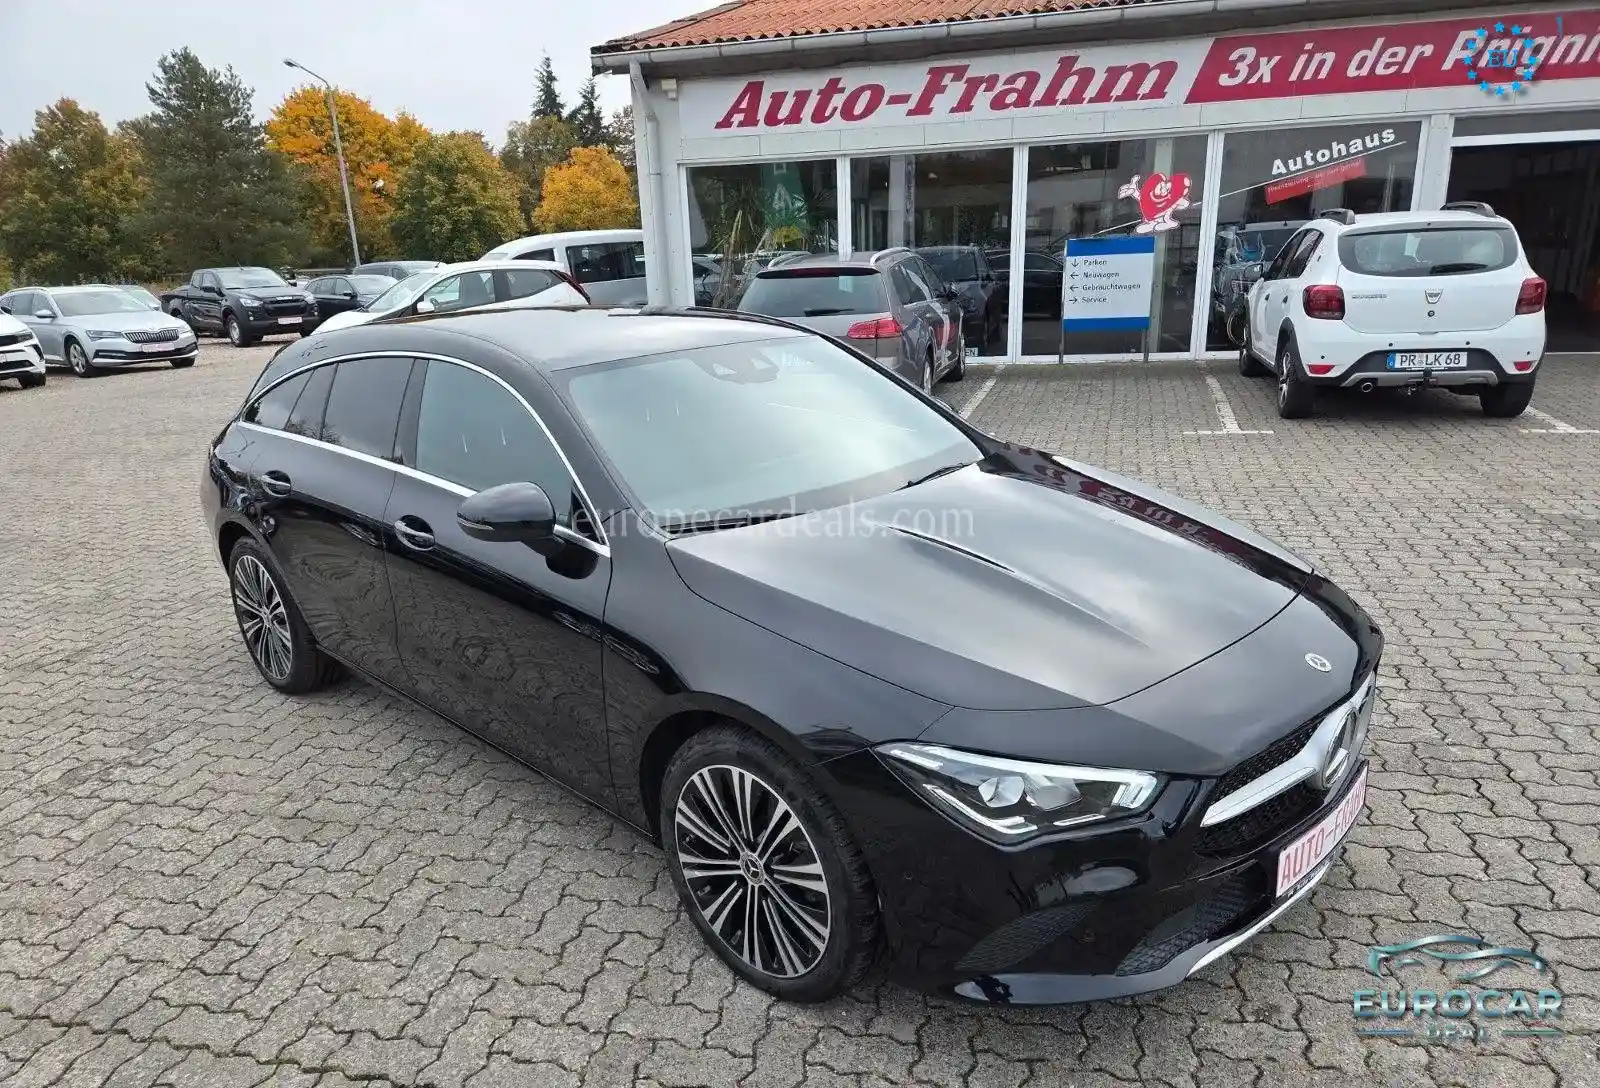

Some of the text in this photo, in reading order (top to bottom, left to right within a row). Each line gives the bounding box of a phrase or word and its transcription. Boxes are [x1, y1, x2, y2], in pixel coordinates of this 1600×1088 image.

[1218, 25, 1600, 87] 3x in der Prigni
[715, 55, 1178, 129] Auto-Frahm
[1271, 128, 1396, 175] Autohaus
[1082, 283, 1141, 291] Gebrauchtwagen
[1400, 353, 1461, 366] PR LK 68
